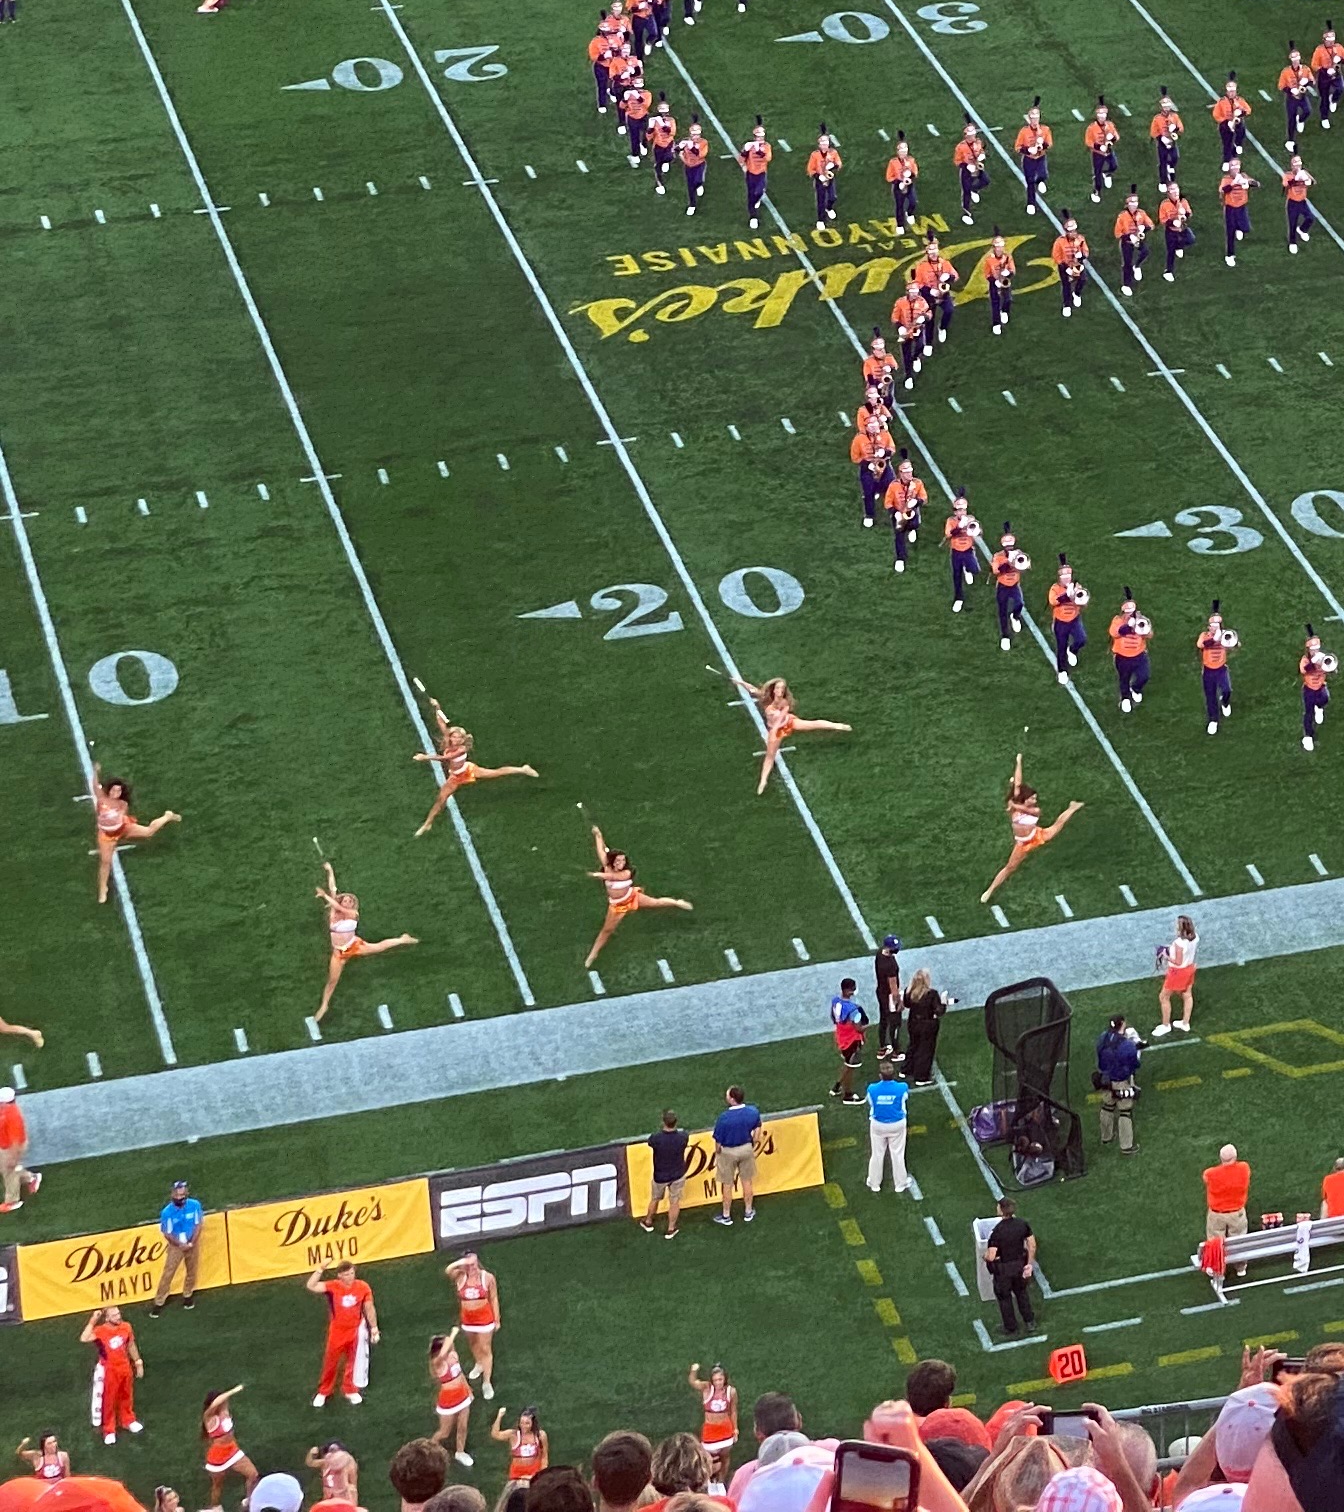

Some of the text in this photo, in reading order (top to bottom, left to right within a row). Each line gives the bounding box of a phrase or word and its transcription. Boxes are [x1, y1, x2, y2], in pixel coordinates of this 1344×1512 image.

[821, 1, 988, 44] 30
[332, 44, 508, 92] 20
[606, 212, 952, 277] MAYONNAISE
[569, 233, 1064, 344] Duke's
[589, 566, 804, 641] 20
[275, 1196, 385, 1247] Duke's
[440, 1163, 618, 1238] ESPN
[65, 1236, 169, 1284] Duke
[308, 1236, 360, 1267] MAYO
[100, 1270, 154, 1303] MAYO
[1057, 1349, 1083, 1378] 20
